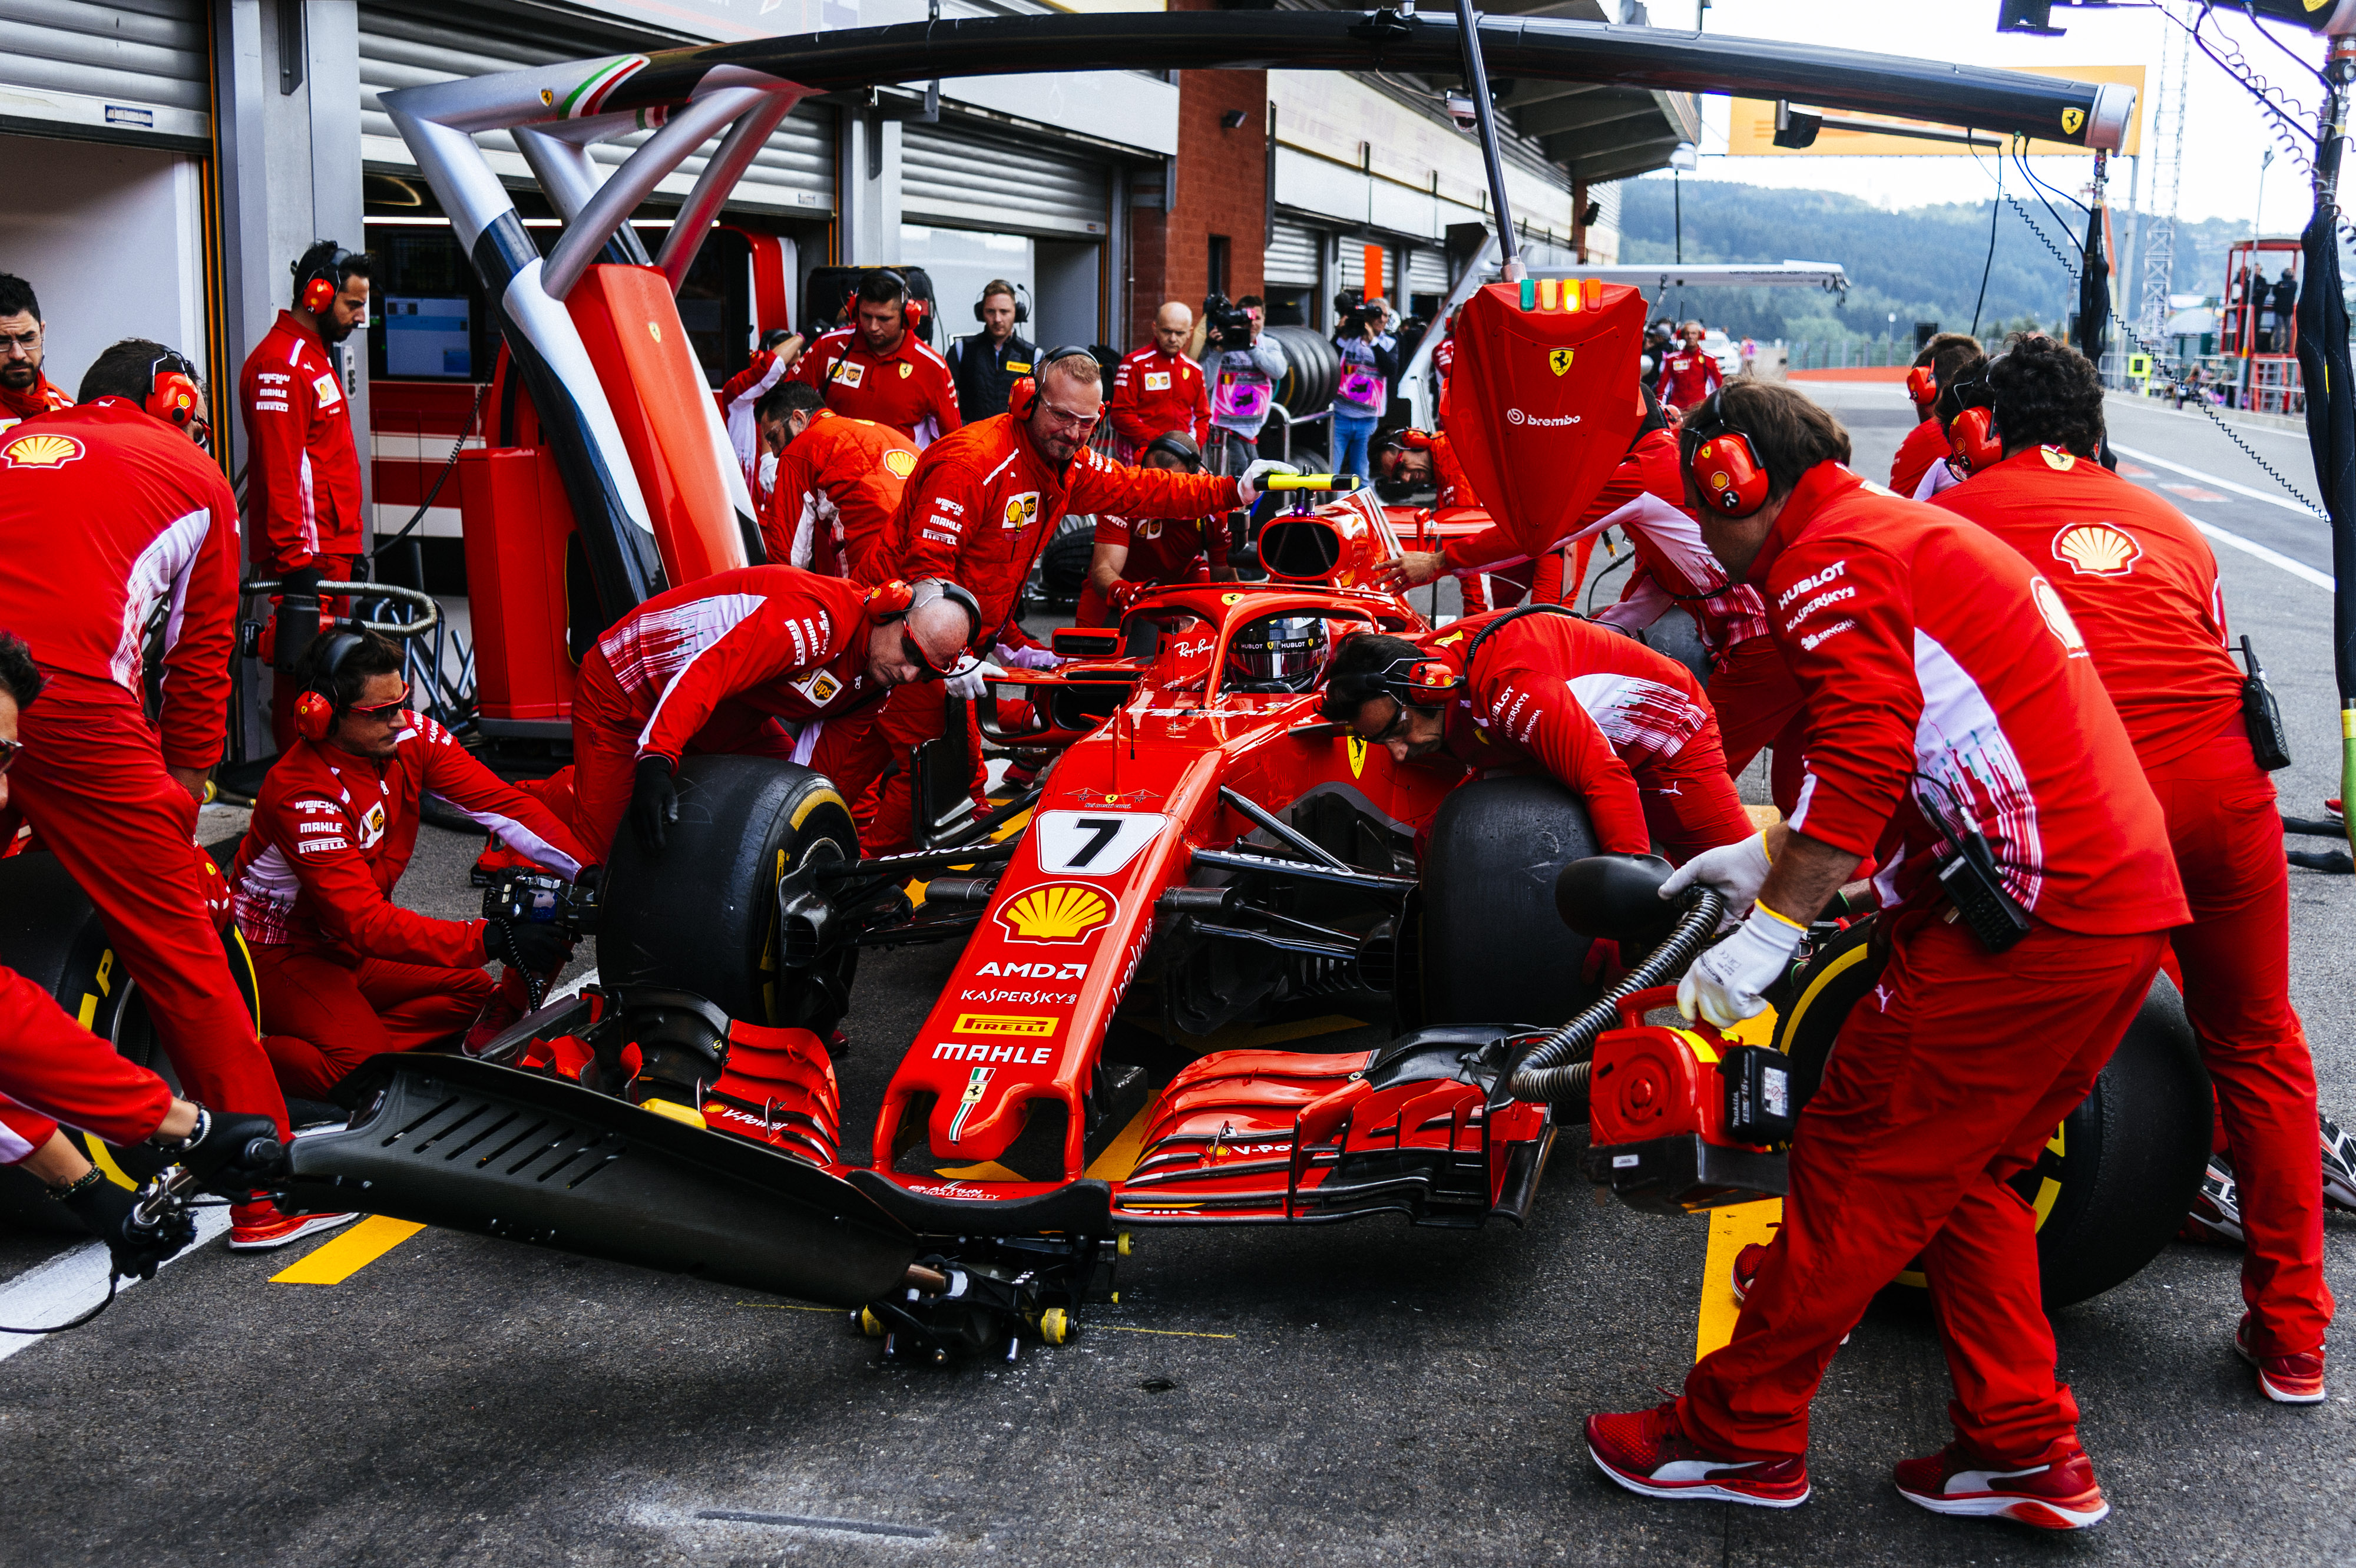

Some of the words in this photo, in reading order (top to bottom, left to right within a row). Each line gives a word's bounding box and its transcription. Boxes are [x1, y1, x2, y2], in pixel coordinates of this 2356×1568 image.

[258, 373, 291, 382] WEICHAI
[846, 370, 860, 381] ups
[260, 388, 287, 398] MAHLE
[256, 401, 289, 412] PIRELLI
[1527, 414, 1581, 426] brembo
[929, 514, 962, 532] MAHLE
[1778, 560, 1846, 611] HUBLOT
[1786, 587, 1847, 633] KASPERSKY
[1818, 618, 1855, 639] SINGHA
[1174, 639, 1215, 658] Ray-Ban
[814, 682, 833, 699] ups
[1525, 710, 1543, 735] SINGHA
[300, 822, 342, 833] MAHLE
[373, 813, 383, 829] ups
[1063, 817, 1126, 869] 7
[1220, 851, 1355, 876] Lenovo
[975, 961, 1056, 978] AMD
[961, 988, 1068, 1005] KASPERSKY
[963, 1018, 1048, 1032] PIRELLI
[932, 1043, 1053, 1064] MAHLE
